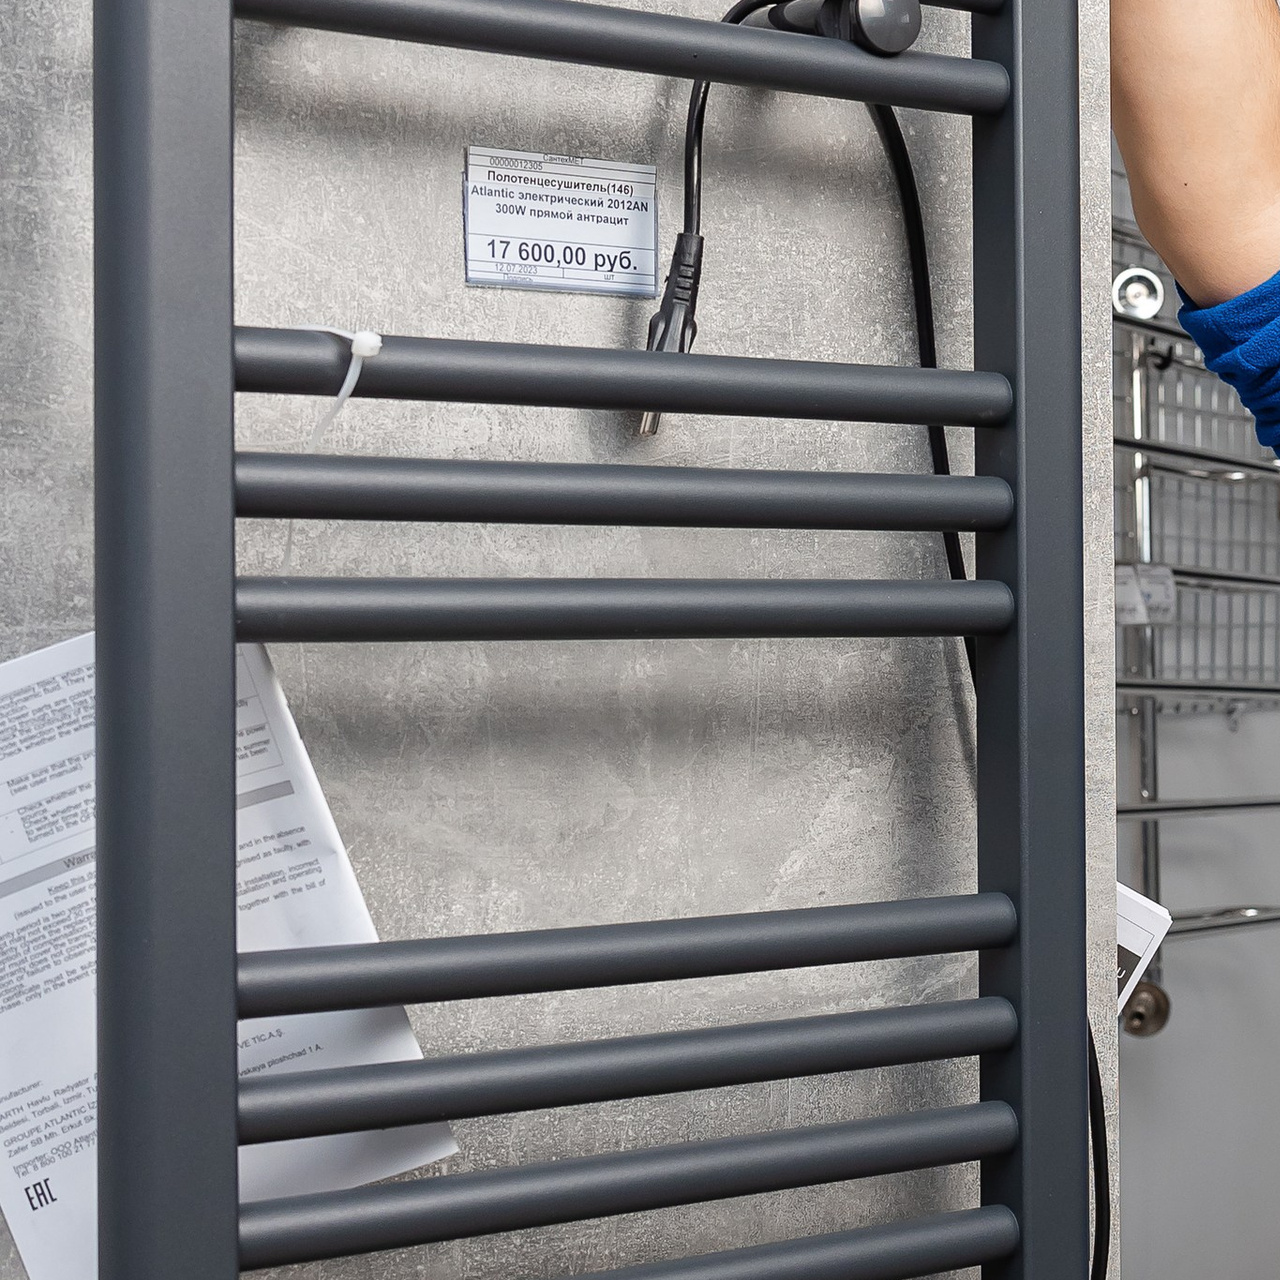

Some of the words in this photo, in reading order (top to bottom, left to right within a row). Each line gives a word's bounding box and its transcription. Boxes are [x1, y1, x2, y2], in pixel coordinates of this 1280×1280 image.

[487, 171, 633, 197] Полотенцесушитель(146)
[471, 185, 515, 199] Atlantic
[518, 191, 604, 208] электрический
[607, 198, 648, 212] 2012AN
[496, 203, 526, 215] 300W
[529, 207, 573, 221] прямой
[577, 213, 629, 226] антрацит
[487, 239, 511, 259] 17
[518, 242, 586, 268] 600,00
[594, 250, 637, 272] руб.
